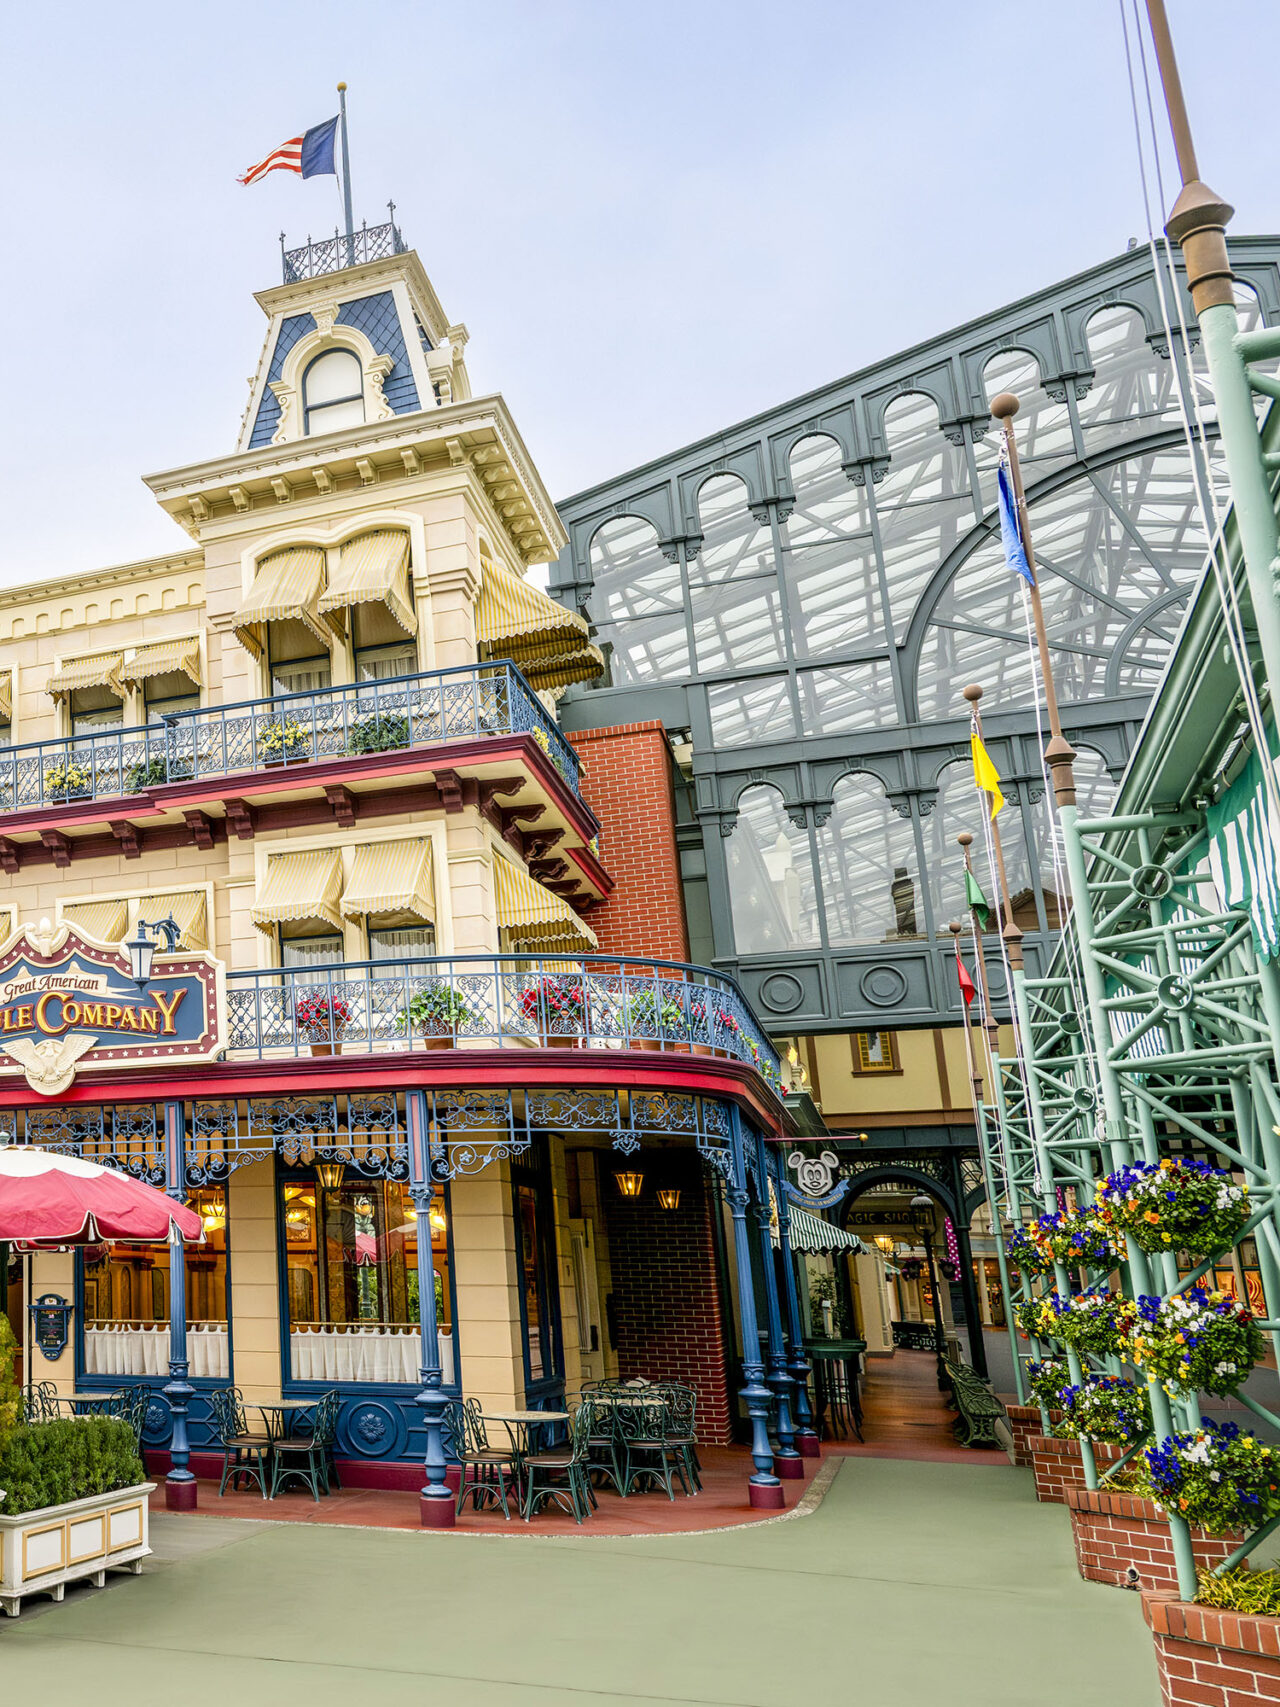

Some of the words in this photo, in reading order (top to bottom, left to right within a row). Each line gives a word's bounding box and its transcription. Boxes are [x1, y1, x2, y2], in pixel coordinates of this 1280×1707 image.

[3, 977, 37, 1004] Great
[38, 974, 99, 991] American
[35, 988, 187, 1036] COMPANY
[847, 1213, 876, 1223] AGIC
